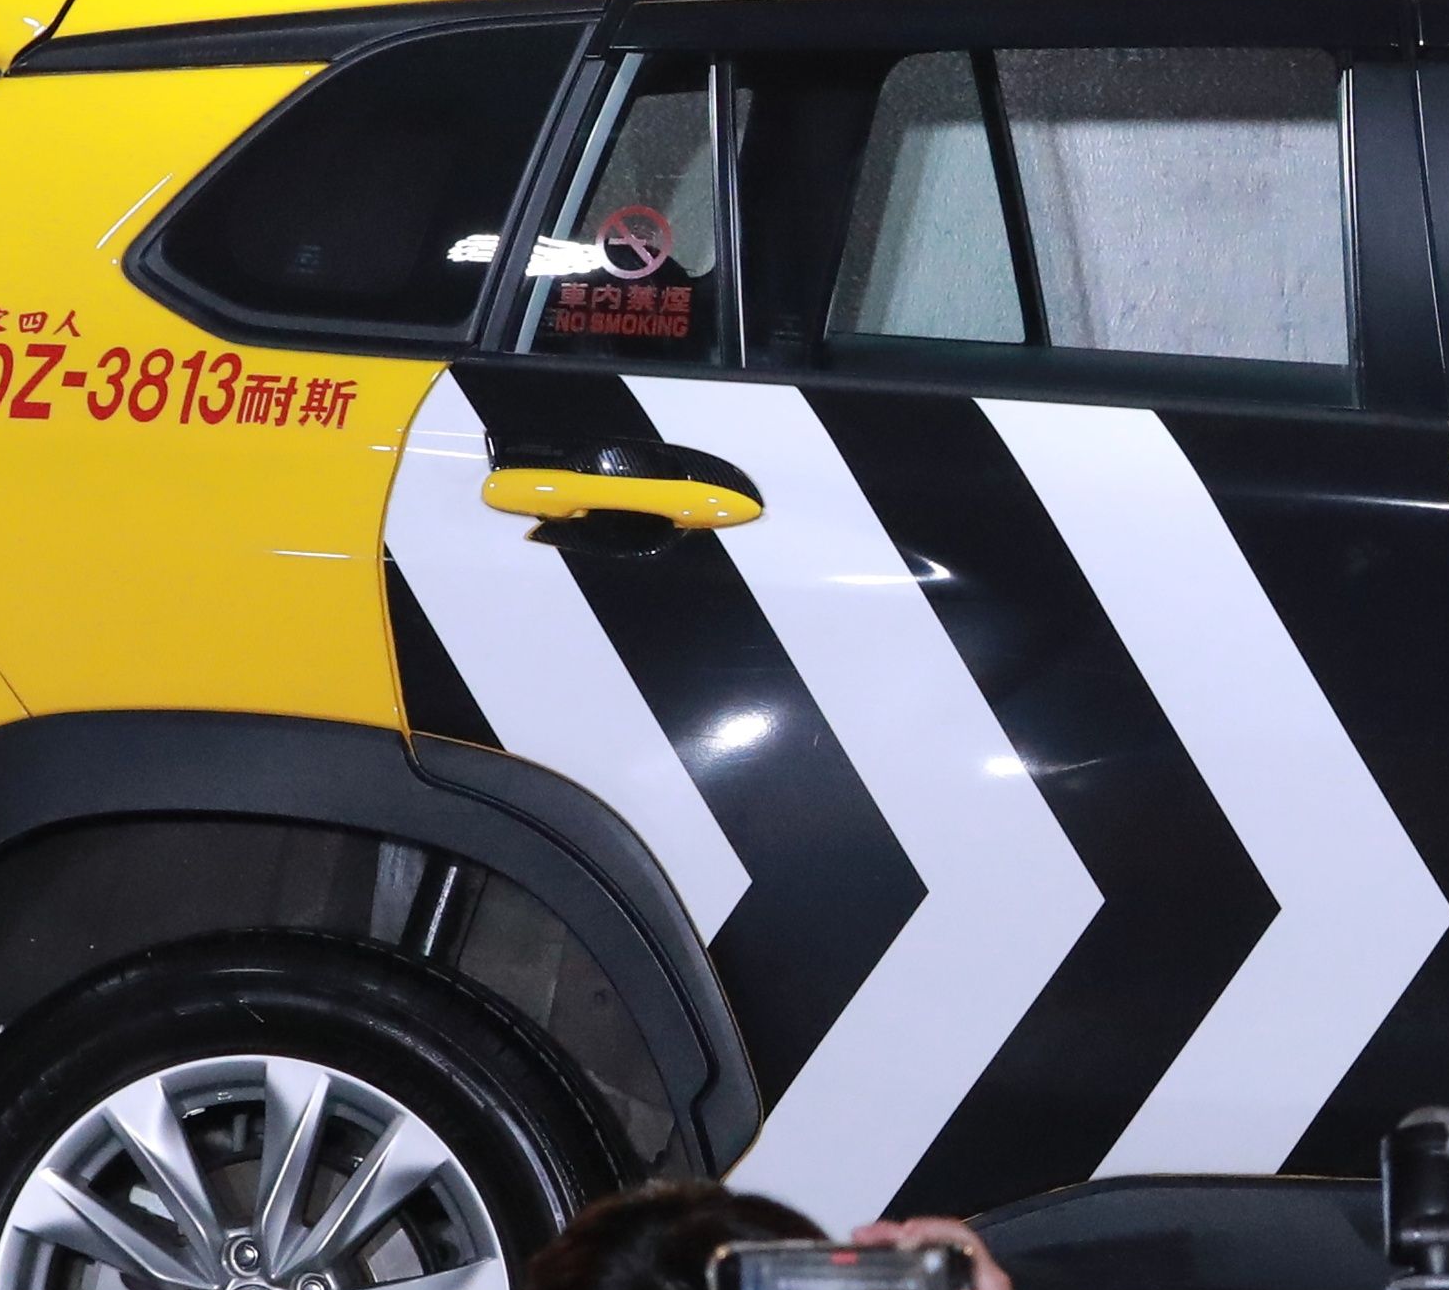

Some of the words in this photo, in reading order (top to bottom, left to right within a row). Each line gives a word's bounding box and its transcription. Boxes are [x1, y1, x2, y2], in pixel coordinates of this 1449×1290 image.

[559, 282, 692, 313] 車內禁煙
[554, 311, 586, 334] NO
[590, 313, 689, 338] SMOKING
